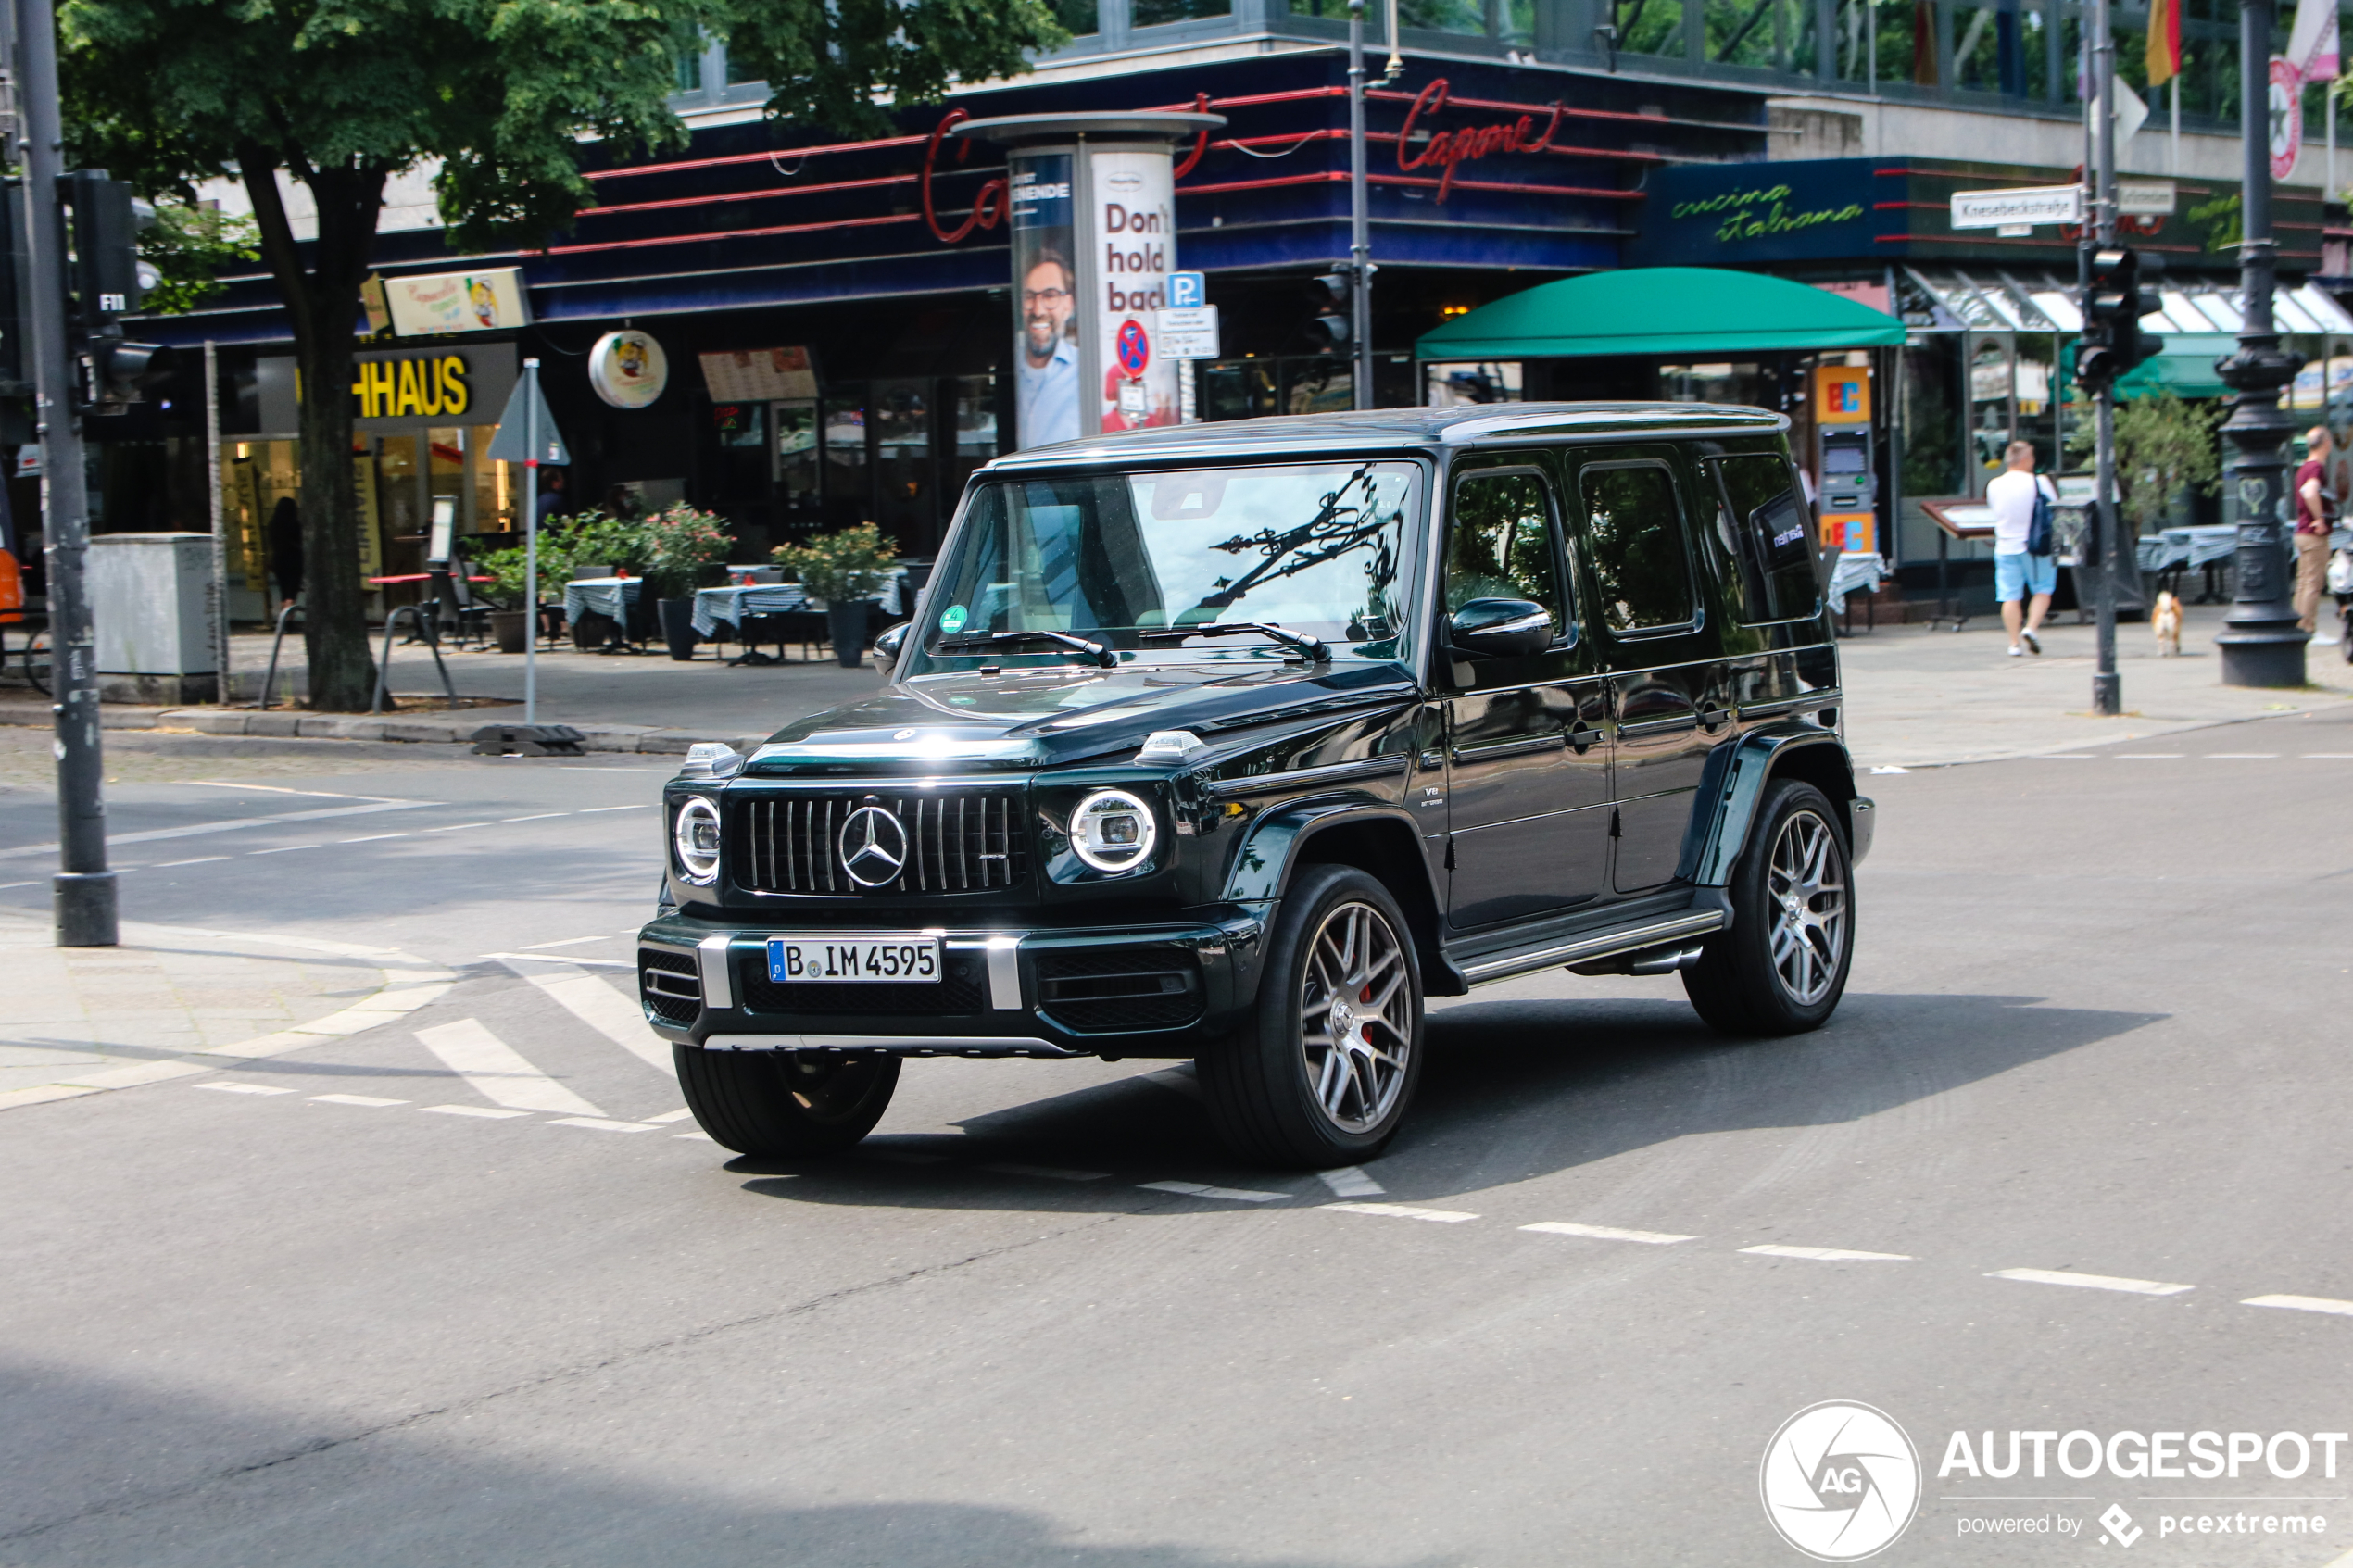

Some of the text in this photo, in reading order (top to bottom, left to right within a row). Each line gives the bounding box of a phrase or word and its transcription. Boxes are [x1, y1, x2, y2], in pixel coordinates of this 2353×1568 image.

[1397, 78, 1565, 204] Capone
[1671, 183, 1793, 219] cucina
[1961, 199, 2070, 220] Knesebeckstraße
[1105, 203, 1171, 235] Don't
[1714, 201, 1865, 243] italiana
[1106, 243, 1164, 273] hold
[1174, 277, 1196, 306] P
[1828, 383, 1861, 413] EC
[950, 608, 958, 620] 4
[1425, 787, 1439, 797] V8
[774, 964, 781, 973] D
[786, 946, 935, 976] B IM 4595
